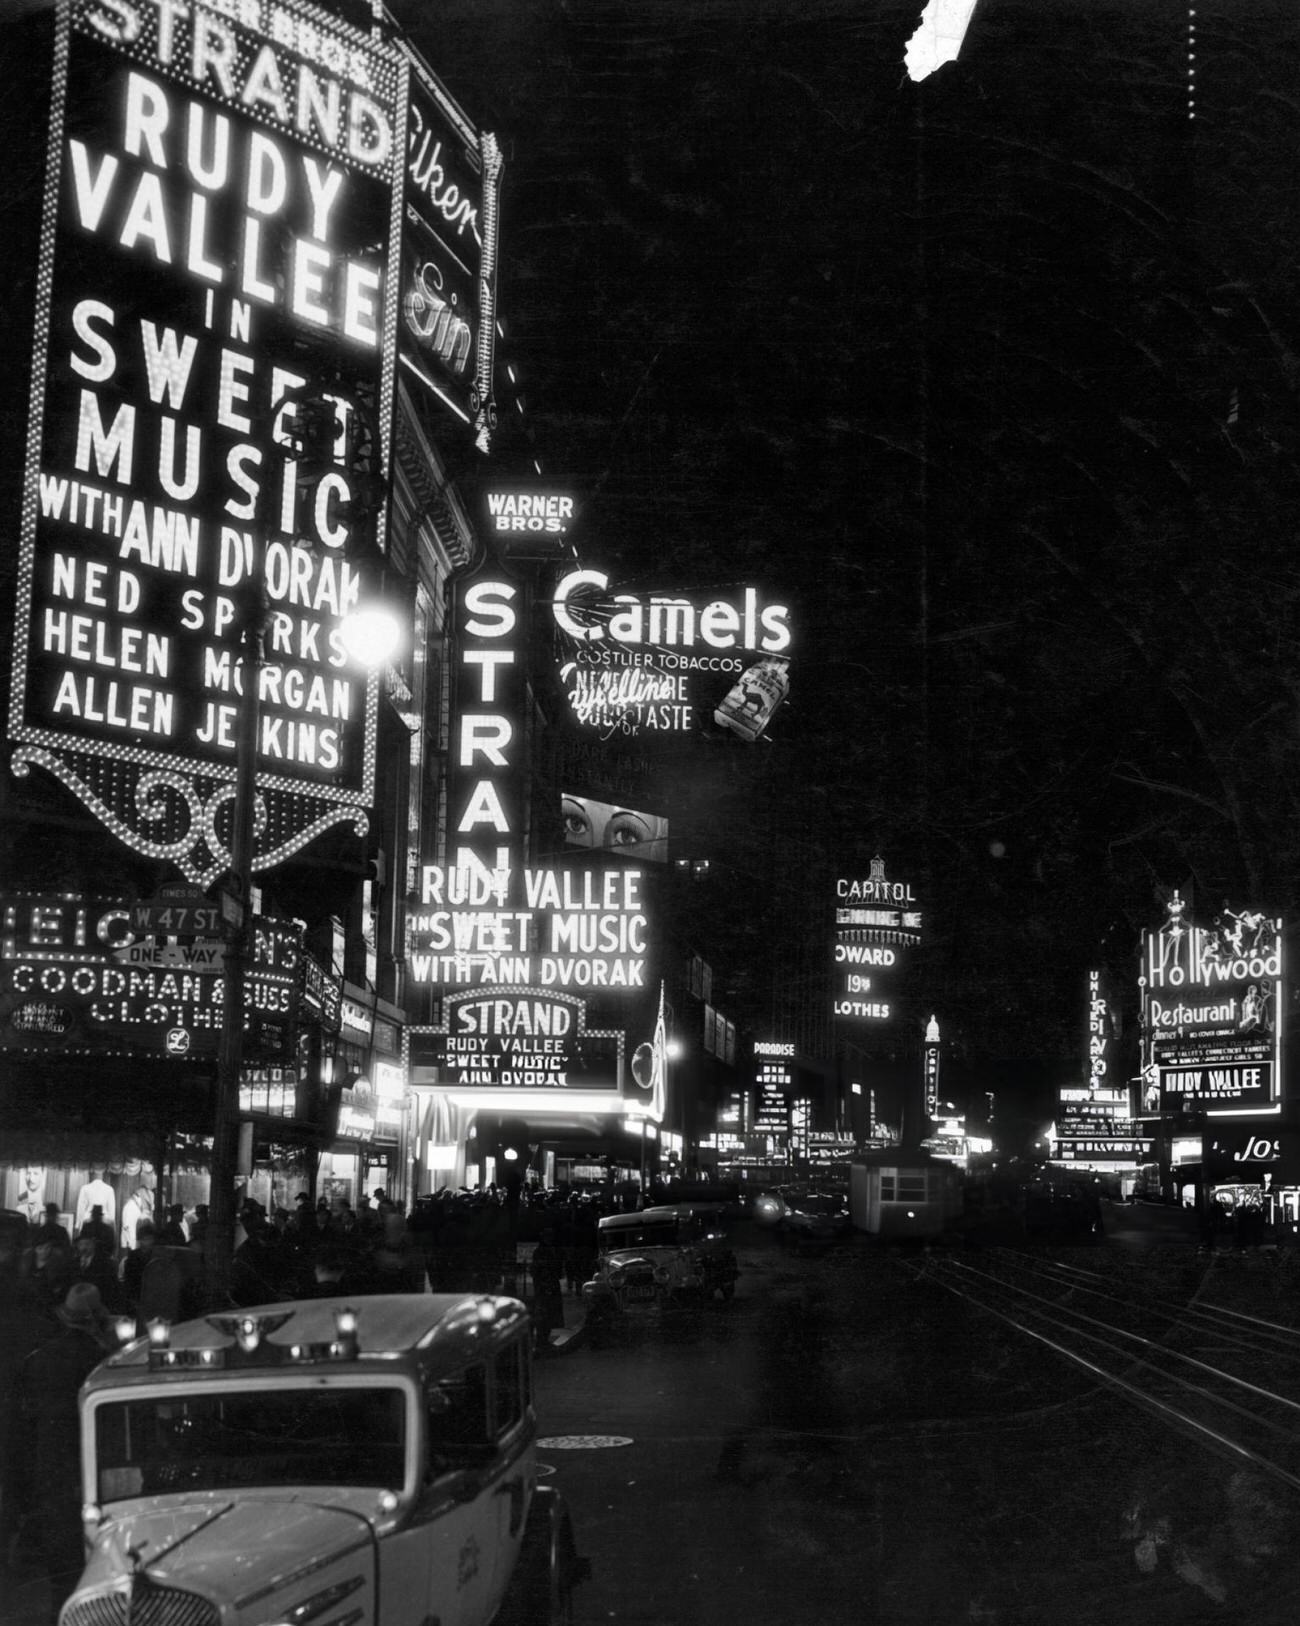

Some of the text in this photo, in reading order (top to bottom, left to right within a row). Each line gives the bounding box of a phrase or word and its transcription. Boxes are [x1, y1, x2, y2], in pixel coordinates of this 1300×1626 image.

[88, 0, 393, 164] STRAND
[124, 71, 342, 242] RUDY
[69, 138, 380, 347] VALLEE
[205, 288, 251, 343] IN
[69, 299, 354, 466] SWEET
[74, 388, 351, 548] MUSIC
[40, 473, 200, 577] WITH ANN
[487, 493, 573, 518] WARNER
[495, 517, 567, 533] BROS.
[52, 553, 350, 668] NED SPRKS
[552, 570, 792, 652] Camels
[44, 608, 169, 678] HELEN
[576, 650, 743, 672] COSTLIER TOBACCOS
[53, 671, 339, 769] ALLEN JEKINS
[456, 582, 517, 966] STRAN
[422, 865, 641, 911] RUDY VALLEE
[836, 879, 916, 901] CAPITOL
[158, 908, 187, 929] 47
[411, 911, 647, 954] IN SWEET MUSIC
[130, 947, 163, 963] ONE
[183, 948, 217, 964] WAY
[411, 955, 644, 986] WITH ANN DVORAK
[12, 965, 201, 1003] GOODMAN
[457, 1000, 571, 1036] STRAND
[1151, 998, 1237, 1027] Restaurant
[446, 1037, 564, 1053] RUDY VALLEE
[754, 1042, 795, 1056] PARADISE
[1208, 1069, 1261, 1090] VALLEE
